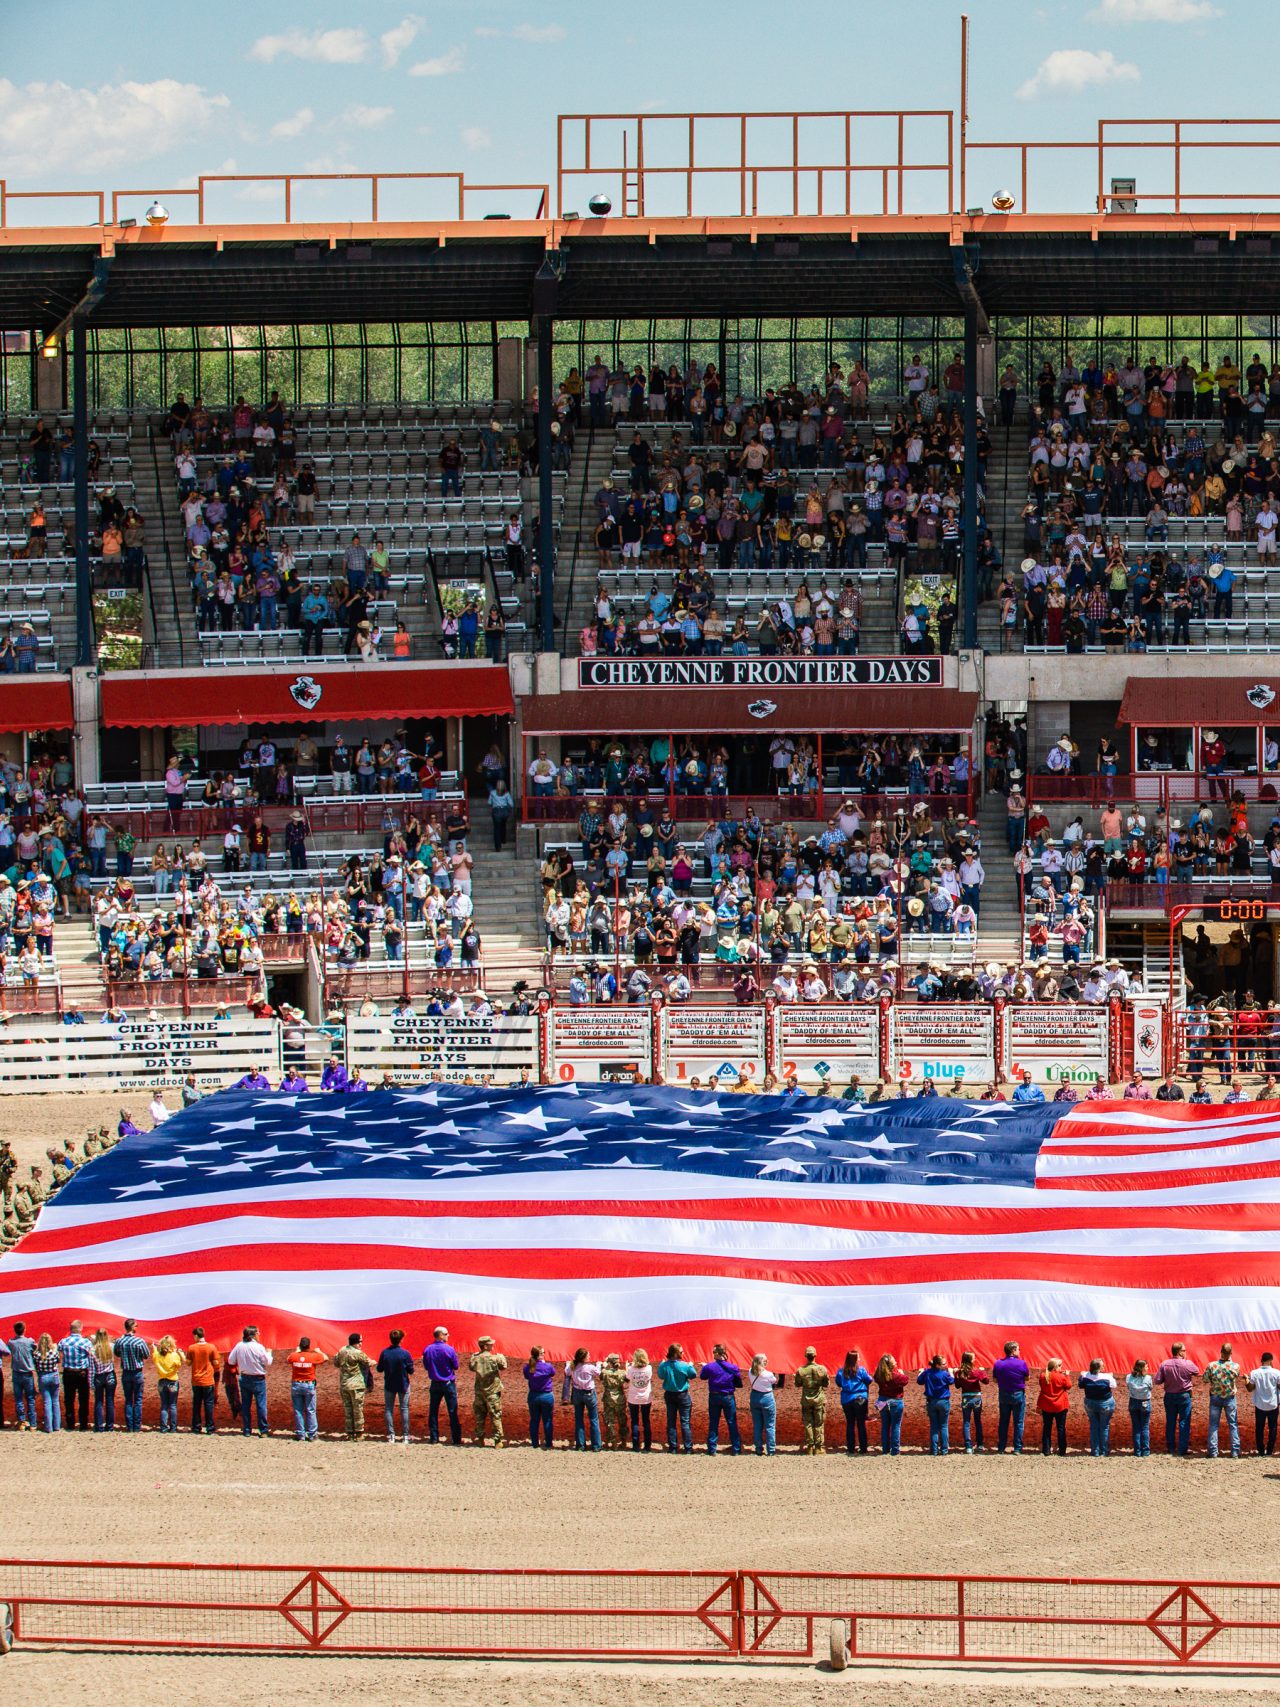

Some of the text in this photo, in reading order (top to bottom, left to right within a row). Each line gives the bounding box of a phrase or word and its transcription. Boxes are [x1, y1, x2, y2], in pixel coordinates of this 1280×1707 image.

[590, 661, 931, 685] CHEYENNE FRONTIER DAYS
[118, 1023, 217, 1033] CHEYENNE
[394, 1019, 493, 1027] CHEYENNE
[119, 1040, 218, 1051] FRONTIER
[394, 1036, 492, 1045] FRONTIER
[145, 1058, 192, 1067] DAYS
[420, 1054, 466, 1062] DAYS
[559, 1064, 574, 1081] 0
[676, 1062, 687, 1079] 1
[783, 1062, 797, 1079] 2
[899, 1060, 911, 1078] 3
[924, 1062, 965, 1077] blue
[1011, 1063, 1024, 1080] 4
[1046, 1067, 1098, 1081] Union
